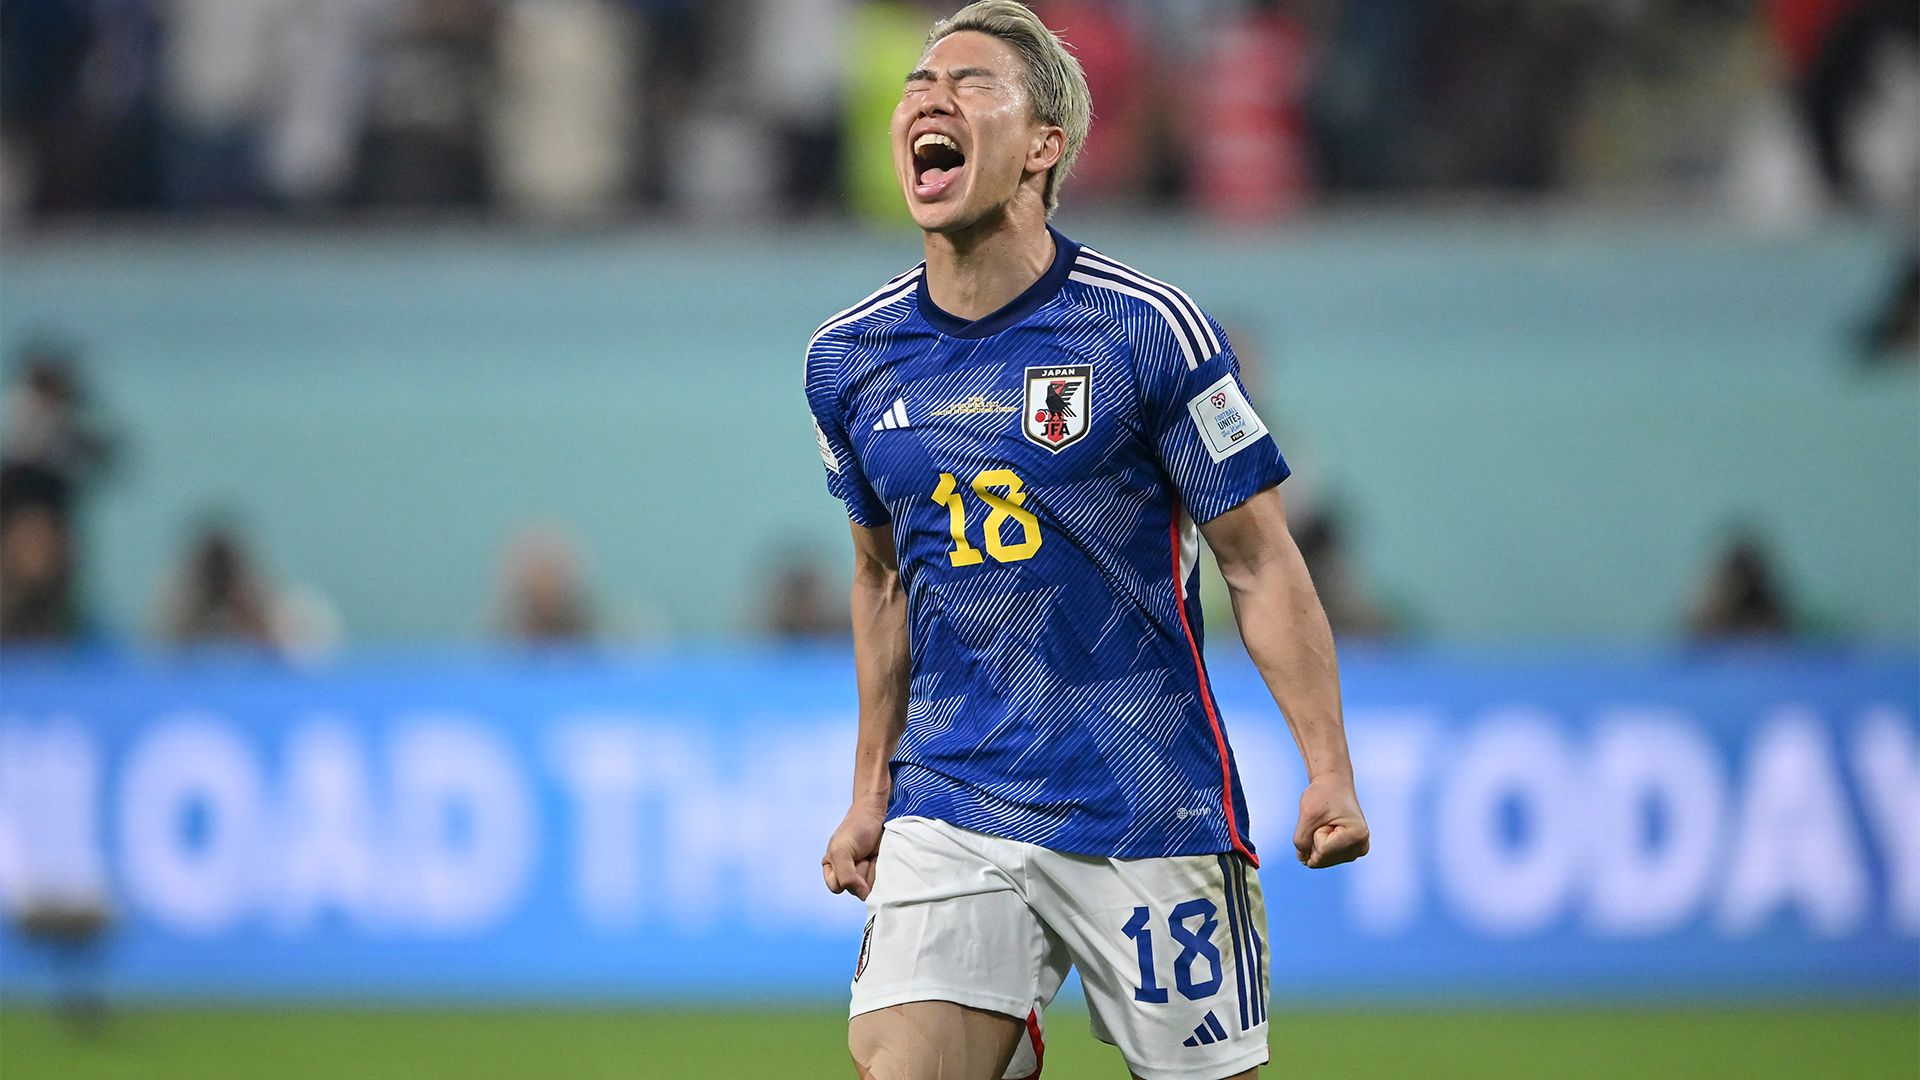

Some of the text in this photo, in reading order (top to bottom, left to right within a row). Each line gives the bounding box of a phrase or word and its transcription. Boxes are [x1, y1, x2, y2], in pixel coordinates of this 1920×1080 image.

[1041, 368, 1076, 377] JAPAN
[1040, 422, 1071, 437] JFA
[1217, 412, 1242, 430] UNITES
[930, 469, 1043, 567] 18
[1121, 898, 1223, 1003] 18
